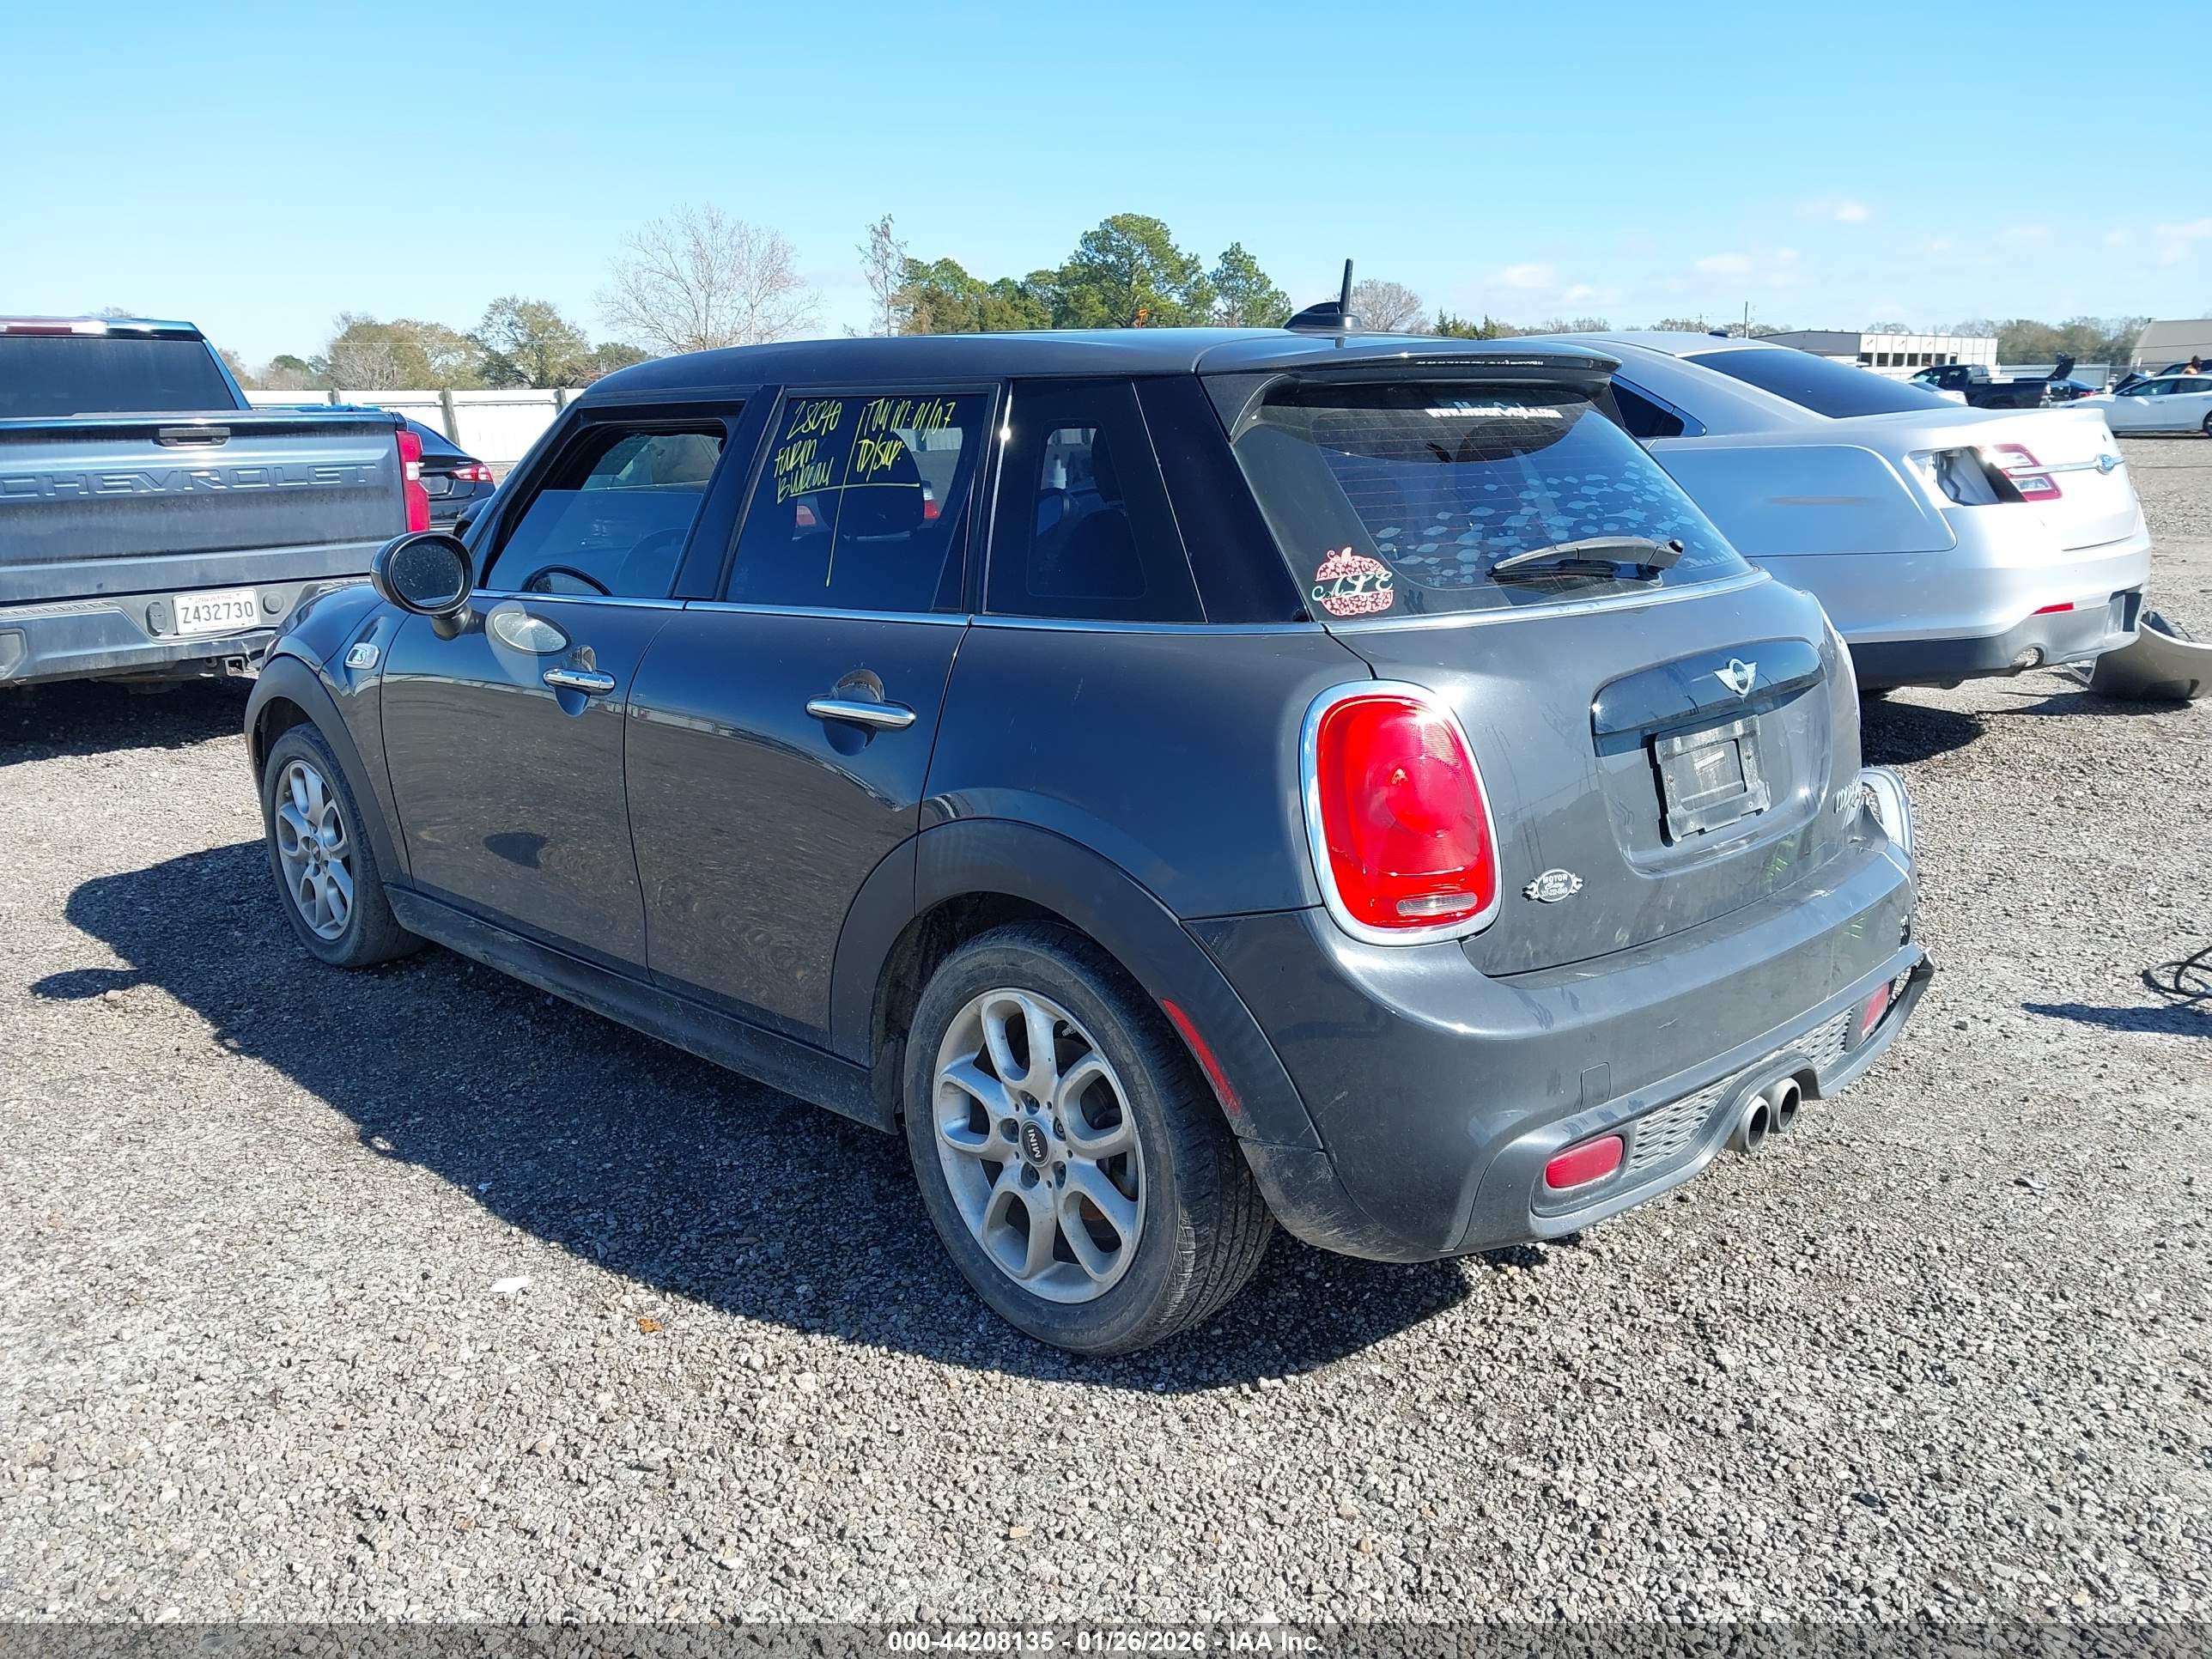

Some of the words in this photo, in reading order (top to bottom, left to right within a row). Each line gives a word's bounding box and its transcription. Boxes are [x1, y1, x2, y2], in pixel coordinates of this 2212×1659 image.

[0, 465, 376, 499] CHEVROLET
[180, 600, 254, 624] Z432730
[1542, 873, 1568, 884] MOTOR
[1028, 1128, 1042, 1158] MINI
